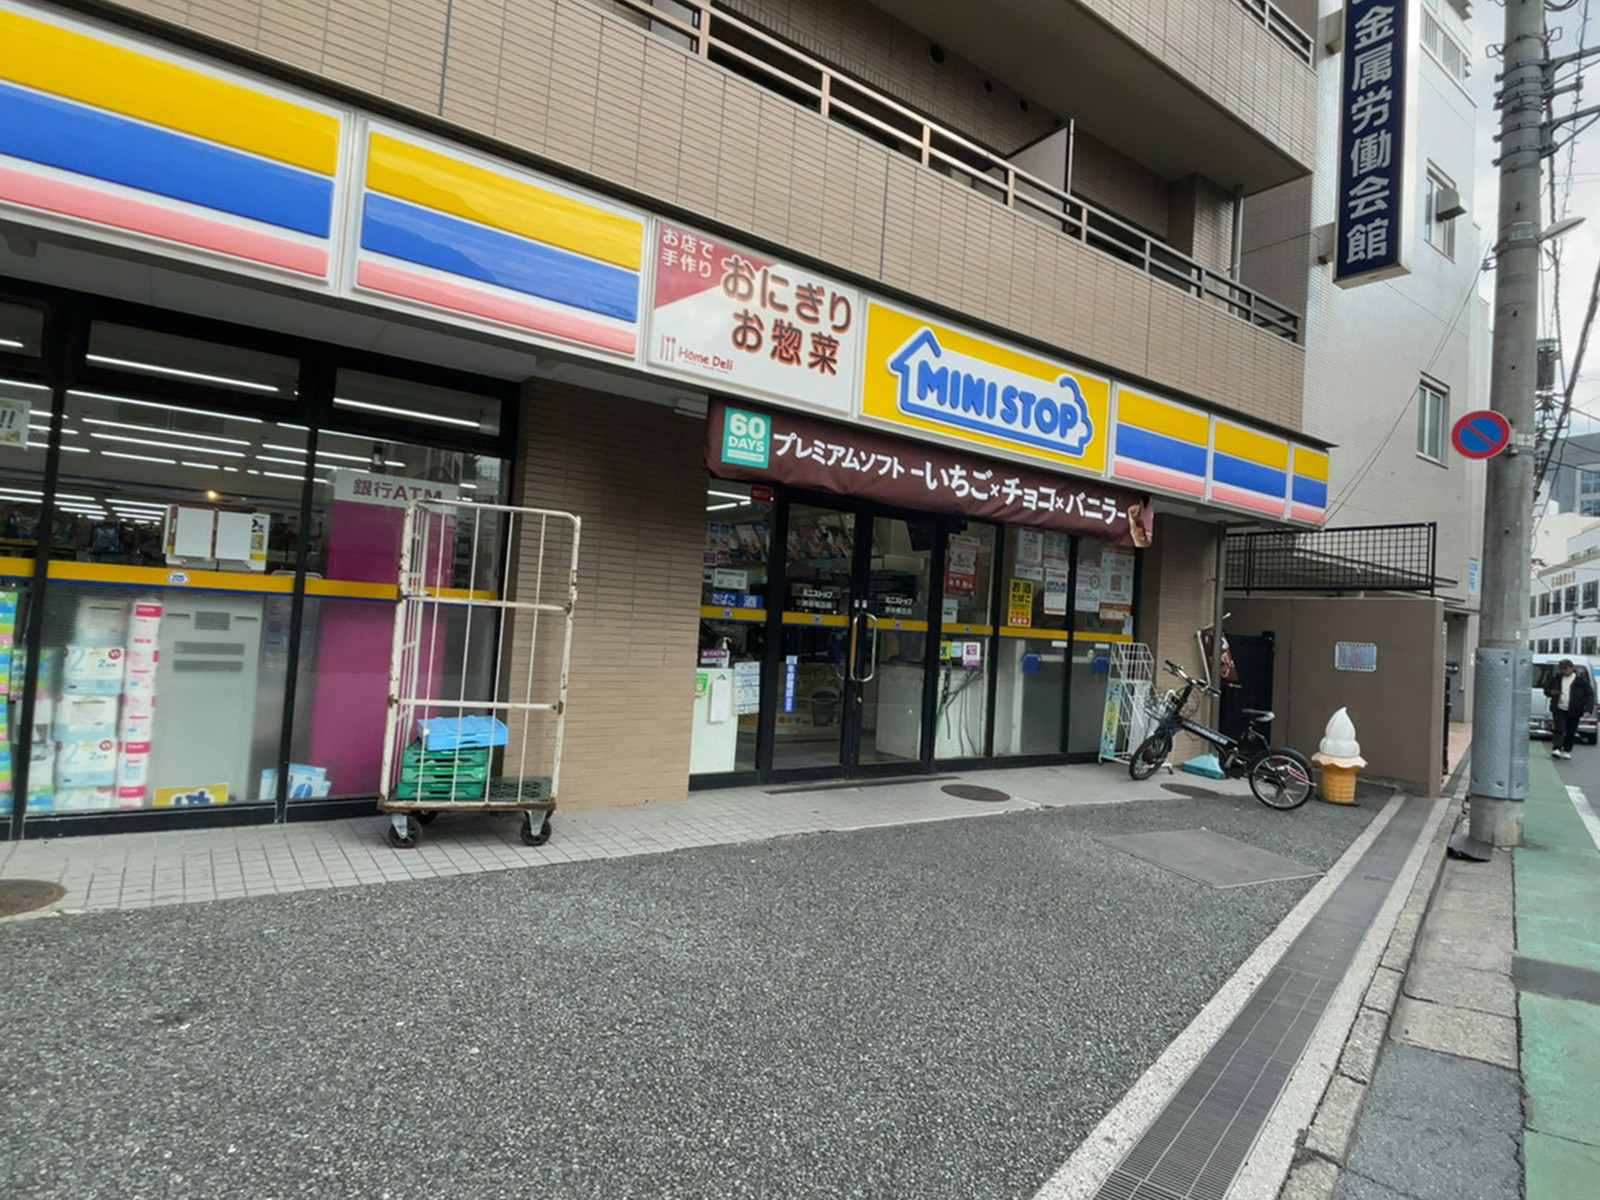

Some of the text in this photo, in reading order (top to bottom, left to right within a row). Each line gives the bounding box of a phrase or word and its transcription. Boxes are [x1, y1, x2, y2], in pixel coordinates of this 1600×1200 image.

[1347, 0, 1395, 264] 金属労働会館
[662, 228, 714, 259] お店で
[662, 248, 712, 278] 手作り
[721, 254, 852, 334] おにぎり
[731, 308, 840, 376] お惣菜
[678, 346, 710, 366] Home
[711, 355, 734, 372] Deli
[729, 412, 767, 440] 60
[728, 435, 765, 453] DAYS
[352, 478, 443, 501] 銀行ATM
[710, 591, 737, 607] たばこ
[803, 588, 833, 599] ミニストップ
